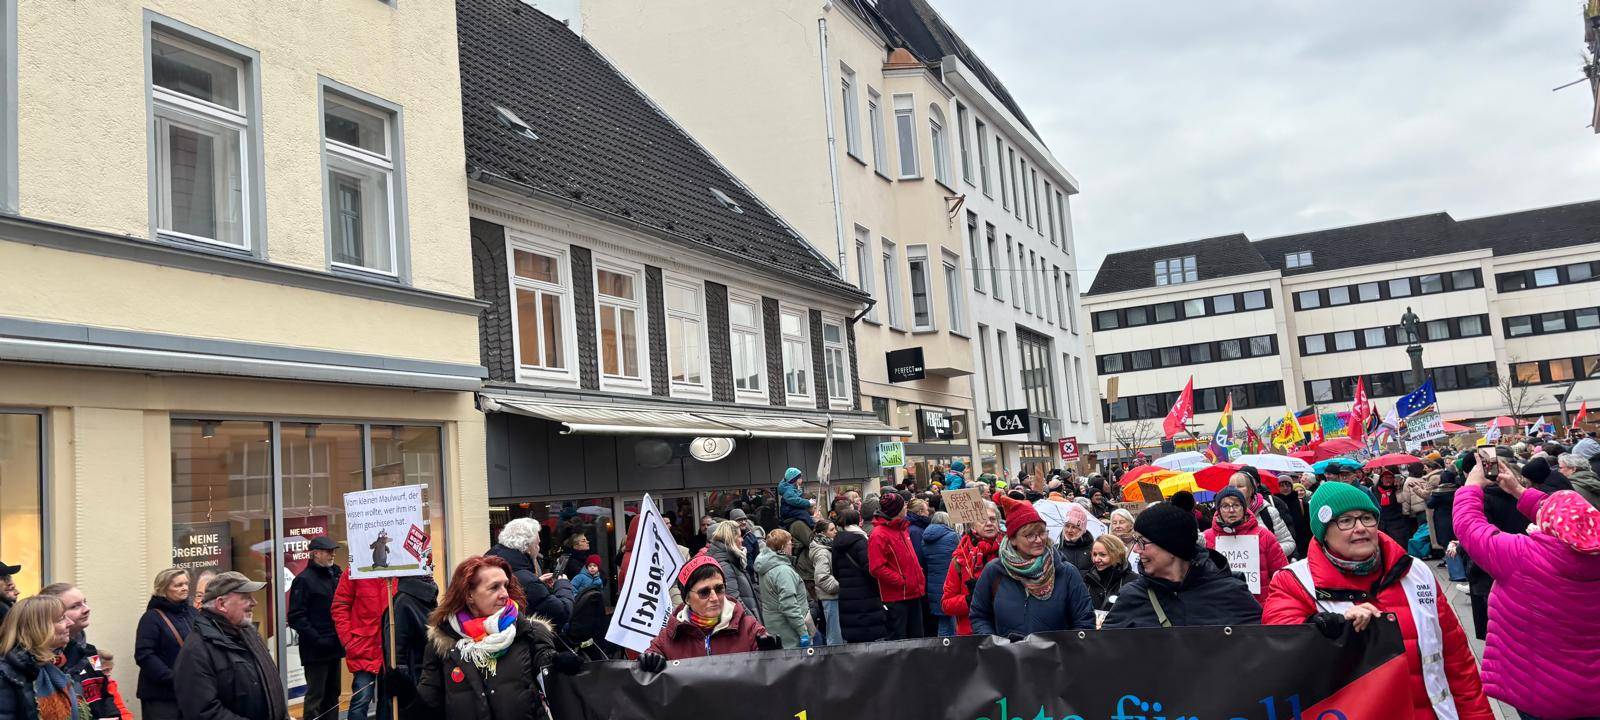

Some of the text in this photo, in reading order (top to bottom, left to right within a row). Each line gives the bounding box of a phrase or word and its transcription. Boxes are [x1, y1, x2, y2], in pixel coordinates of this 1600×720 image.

[995, 414, 1024, 431] C&A
[346, 498, 358, 506] Vom
[359, 496, 378, 504] kleinen
[408, 491, 419, 500] der
[347, 510, 364, 518] wissen
[383, 507, 395, 515] wer
[395, 505, 407, 513] ihm
[948, 501, 969, 511] HASS
[289, 526, 324, 536] NIE WIEDER
[189, 533, 219, 545] MEINE
[172, 545, 222, 558] ÖRGERÄTE:
[292, 552, 310, 561] WECH
[172, 561, 191, 569] RASSE
